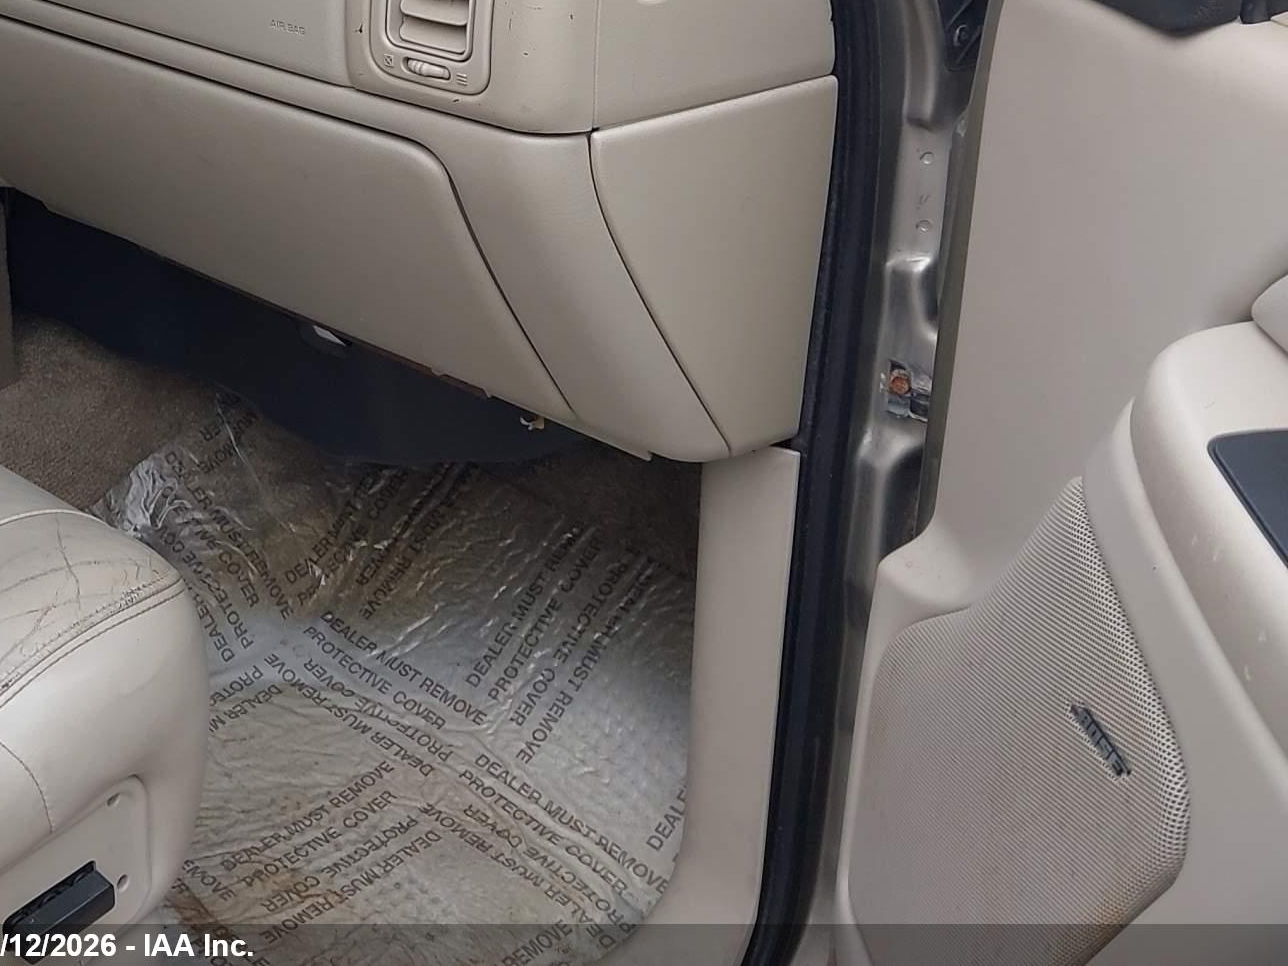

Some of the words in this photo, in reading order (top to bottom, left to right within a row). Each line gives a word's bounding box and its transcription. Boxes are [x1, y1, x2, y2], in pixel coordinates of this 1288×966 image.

[218, 550, 260, 609] COVER
[245, 548, 295, 621] REMOVE
[360, 554, 412, 620] REMOVE
[465, 618, 516, 689] DEALER
[512, 571, 547, 623] MUST
[487, 598, 562, 702] PROTECTIVE
[264, 653, 329, 707] REMOVE
[303, 657, 355, 698] COVER
[303, 626, 392, 695] PROTECTIVE
[392, 689, 447, 731] COVER
[320, 610, 378, 655] DEALER
[376, 649, 423, 684] MUST
[418, 676, 488, 727] REMOVE
[509, 667, 556, 727] COVER
[567, 636, 609, 693] MUST
[224, 683, 283, 721] DEALER
[325, 702, 373, 734] MUST
[353, 695, 454, 763] PROTECTIVE
[515, 690, 573, 764] REMOVE
[370, 732, 436, 778] DEALER
[220, 832, 289, 873] DEALER
[284, 804, 331, 842] MUST
[329, 760, 396, 809] REMOVE
[240, 826, 343, 888] PROTECTIVE
[342, 789, 398, 829] COVER
[320, 814, 419, 880] PROTECTIVE
[417, 802, 493, 854] REMOVE
[459, 769, 563, 846] PROTECTIVE
[565, 844, 629, 897] COVER
[474, 753, 545, 805] DEALER
[543, 799, 597, 840] MUST
[596, 835, 669, 895] REMOVE
[377, 829, 443, 876] DEALER
[491, 851, 547, 888] MUST
[261, 874, 321, 914] COVER
[261, 892, 335, 945] REMOVE
[332, 871, 383, 909] MUST
[522, 846, 638, 935] PROTECTIVE
[544, 882, 617, 950] DEALER
